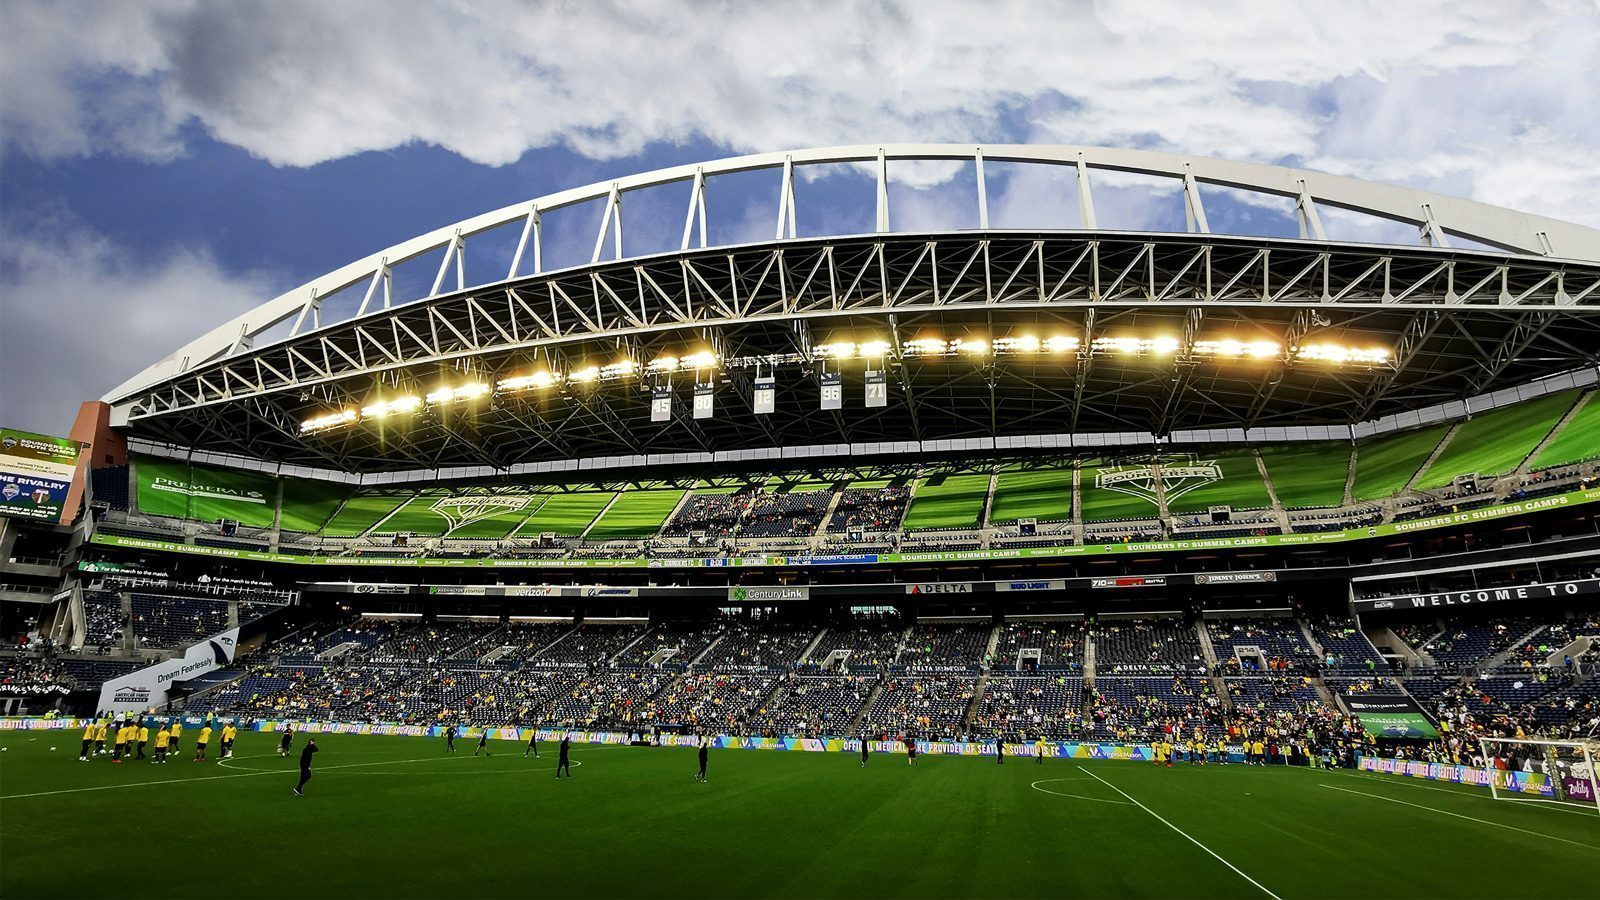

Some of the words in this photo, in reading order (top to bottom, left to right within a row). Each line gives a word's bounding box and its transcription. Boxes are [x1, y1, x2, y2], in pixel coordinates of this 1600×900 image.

[822, 387, 840, 400] 96
[868, 384, 884, 398] 71
[756, 391, 771, 404] 12
[653, 400, 669, 412] 45
[20, 440, 64, 450] SOUNDERS
[48, 448, 76, 456] CAMPS
[1104, 470, 1187, 483] SOUNERS
[17, 478, 66, 490] RIVALRY
[155, 477, 238, 494] PREMERA
[1394, 517, 1451, 532] SOUNDERS
[1455, 514, 1468, 522] FC
[1472, 505, 1522, 518] SUMMER
[1525, 496, 1568, 510] CAMPS
[117, 538, 162, 550] SOUNDERS
[177, 545, 211, 554] SUMMER
[1127, 542, 1174, 551] SOUNDERS
[516, 588, 547, 596] verizon
[748, 589, 802, 599] CenturyLink
[926, 584, 967, 593] DELTA
[1412, 588, 1528, 607] WELCOME
[1546, 583, 1578, 596] TO
[158, 669, 180, 684] Dream
[181, 657, 212, 676] Fearlessly
[42, 685, 71, 695] SUPPORT
[0, 720, 27, 729] SEATTLE
[29, 720, 62, 729] SOUNDERS
[66, 720, 74, 729] FC
[299, 724, 321, 732] MEDICAL
[336, 725, 361, 733] PROVIDER
[364, 725, 369, 733] OF
[371, 726, 392, 734] SEATTLE
[394, 726, 420, 735] SOUNDERS
[422, 727, 429, 735] FC
[535, 731, 564, 741] OFFICIAL
[589, 733, 604, 742] CARE
[606, 734, 631, 744] PROVID
[709, 737, 716, 746] FC
[876, 742, 907, 752] MEDICAL
[929, 743, 964, 753] PROVIDER
[966, 744, 975, 754] OF
[1052, 746, 1060, 755] FC
[1361, 758, 1377, 769] OFFICIAL
[1378, 760, 1394, 771] MEDICAL
[1396, 761, 1406, 773] CARE
[1407, 762, 1428, 776] PROVIDER
[1430, 764, 1436, 776] OF
[1437, 765, 1458, 780] SEATTLE
[1460, 767, 1490, 783] SOUNDERS
[1517, 782, 1534, 792] Virginia
[1536, 781, 1552, 792] Mason
